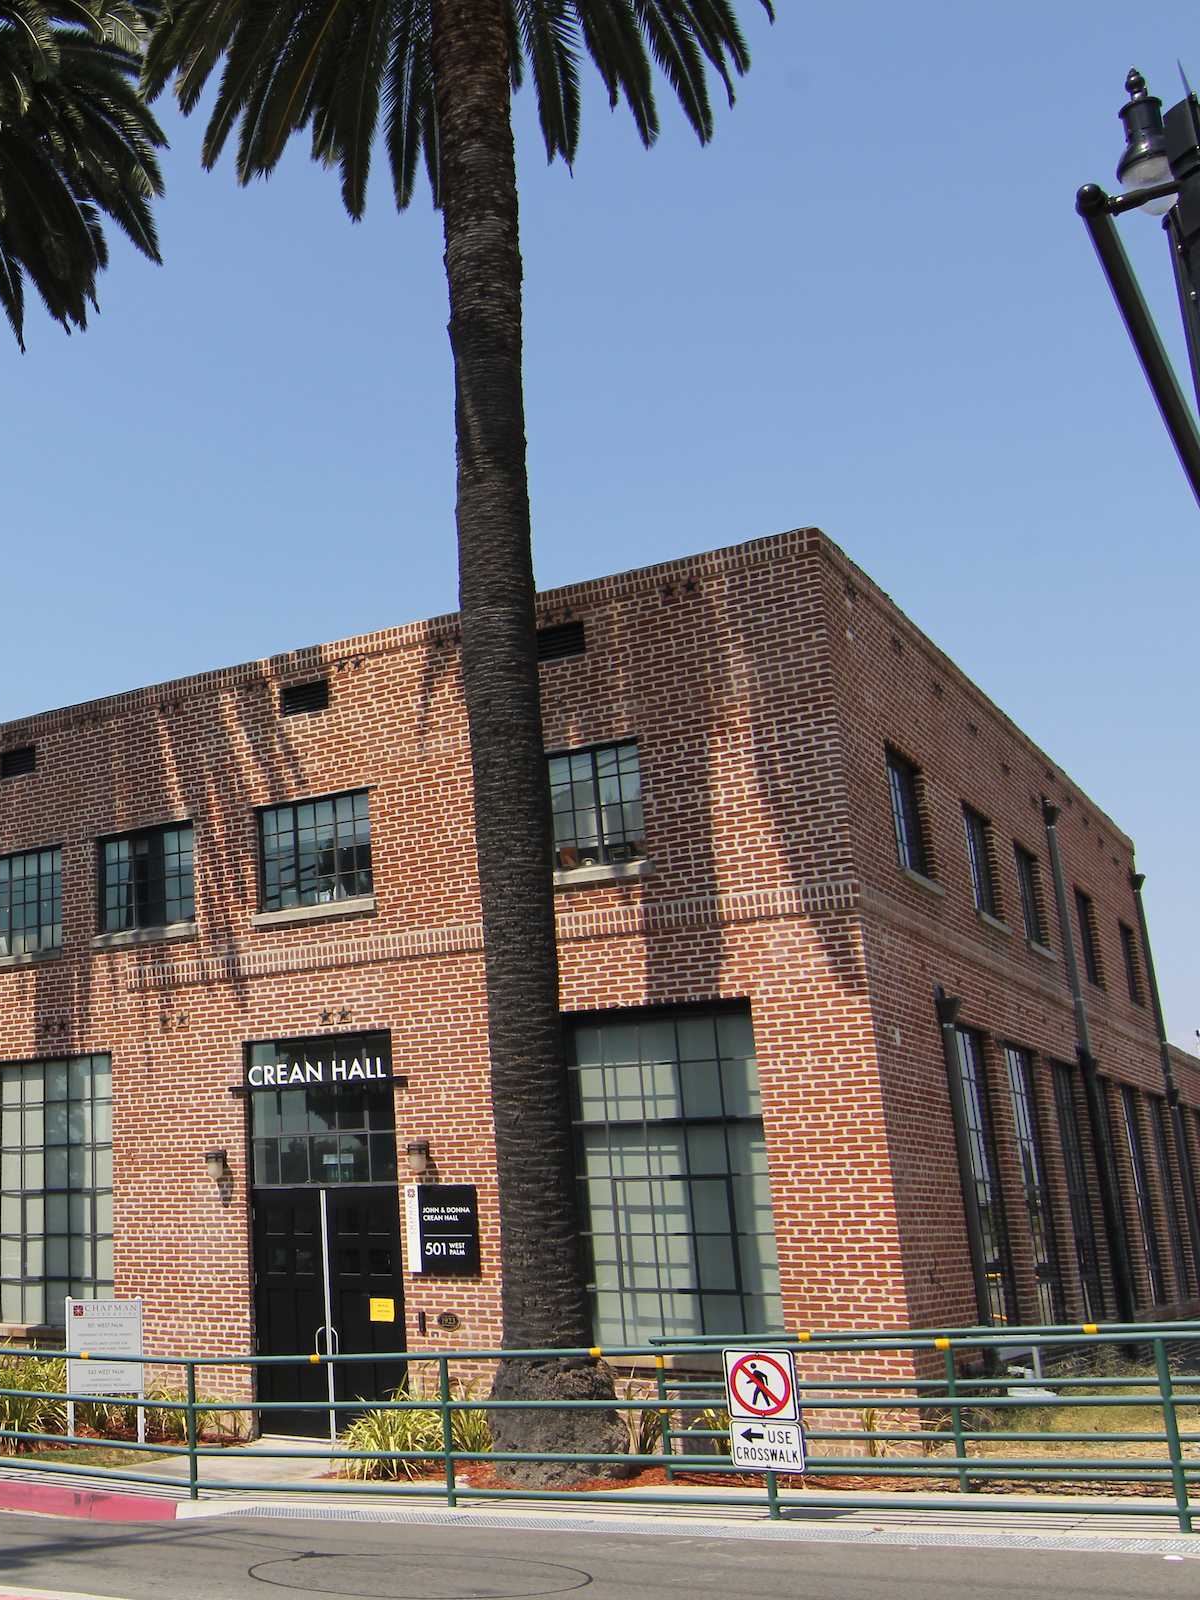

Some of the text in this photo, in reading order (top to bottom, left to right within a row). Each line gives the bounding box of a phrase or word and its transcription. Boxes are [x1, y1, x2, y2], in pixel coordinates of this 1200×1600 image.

[248, 1057, 387, 1086] CREAN HALL
[425, 1242, 447, 1255] 501
[441, 1317, 456, 1325] 1923
[767, 1430, 793, 1444] USE
[736, 1446, 799, 1463] CROSSWALK
